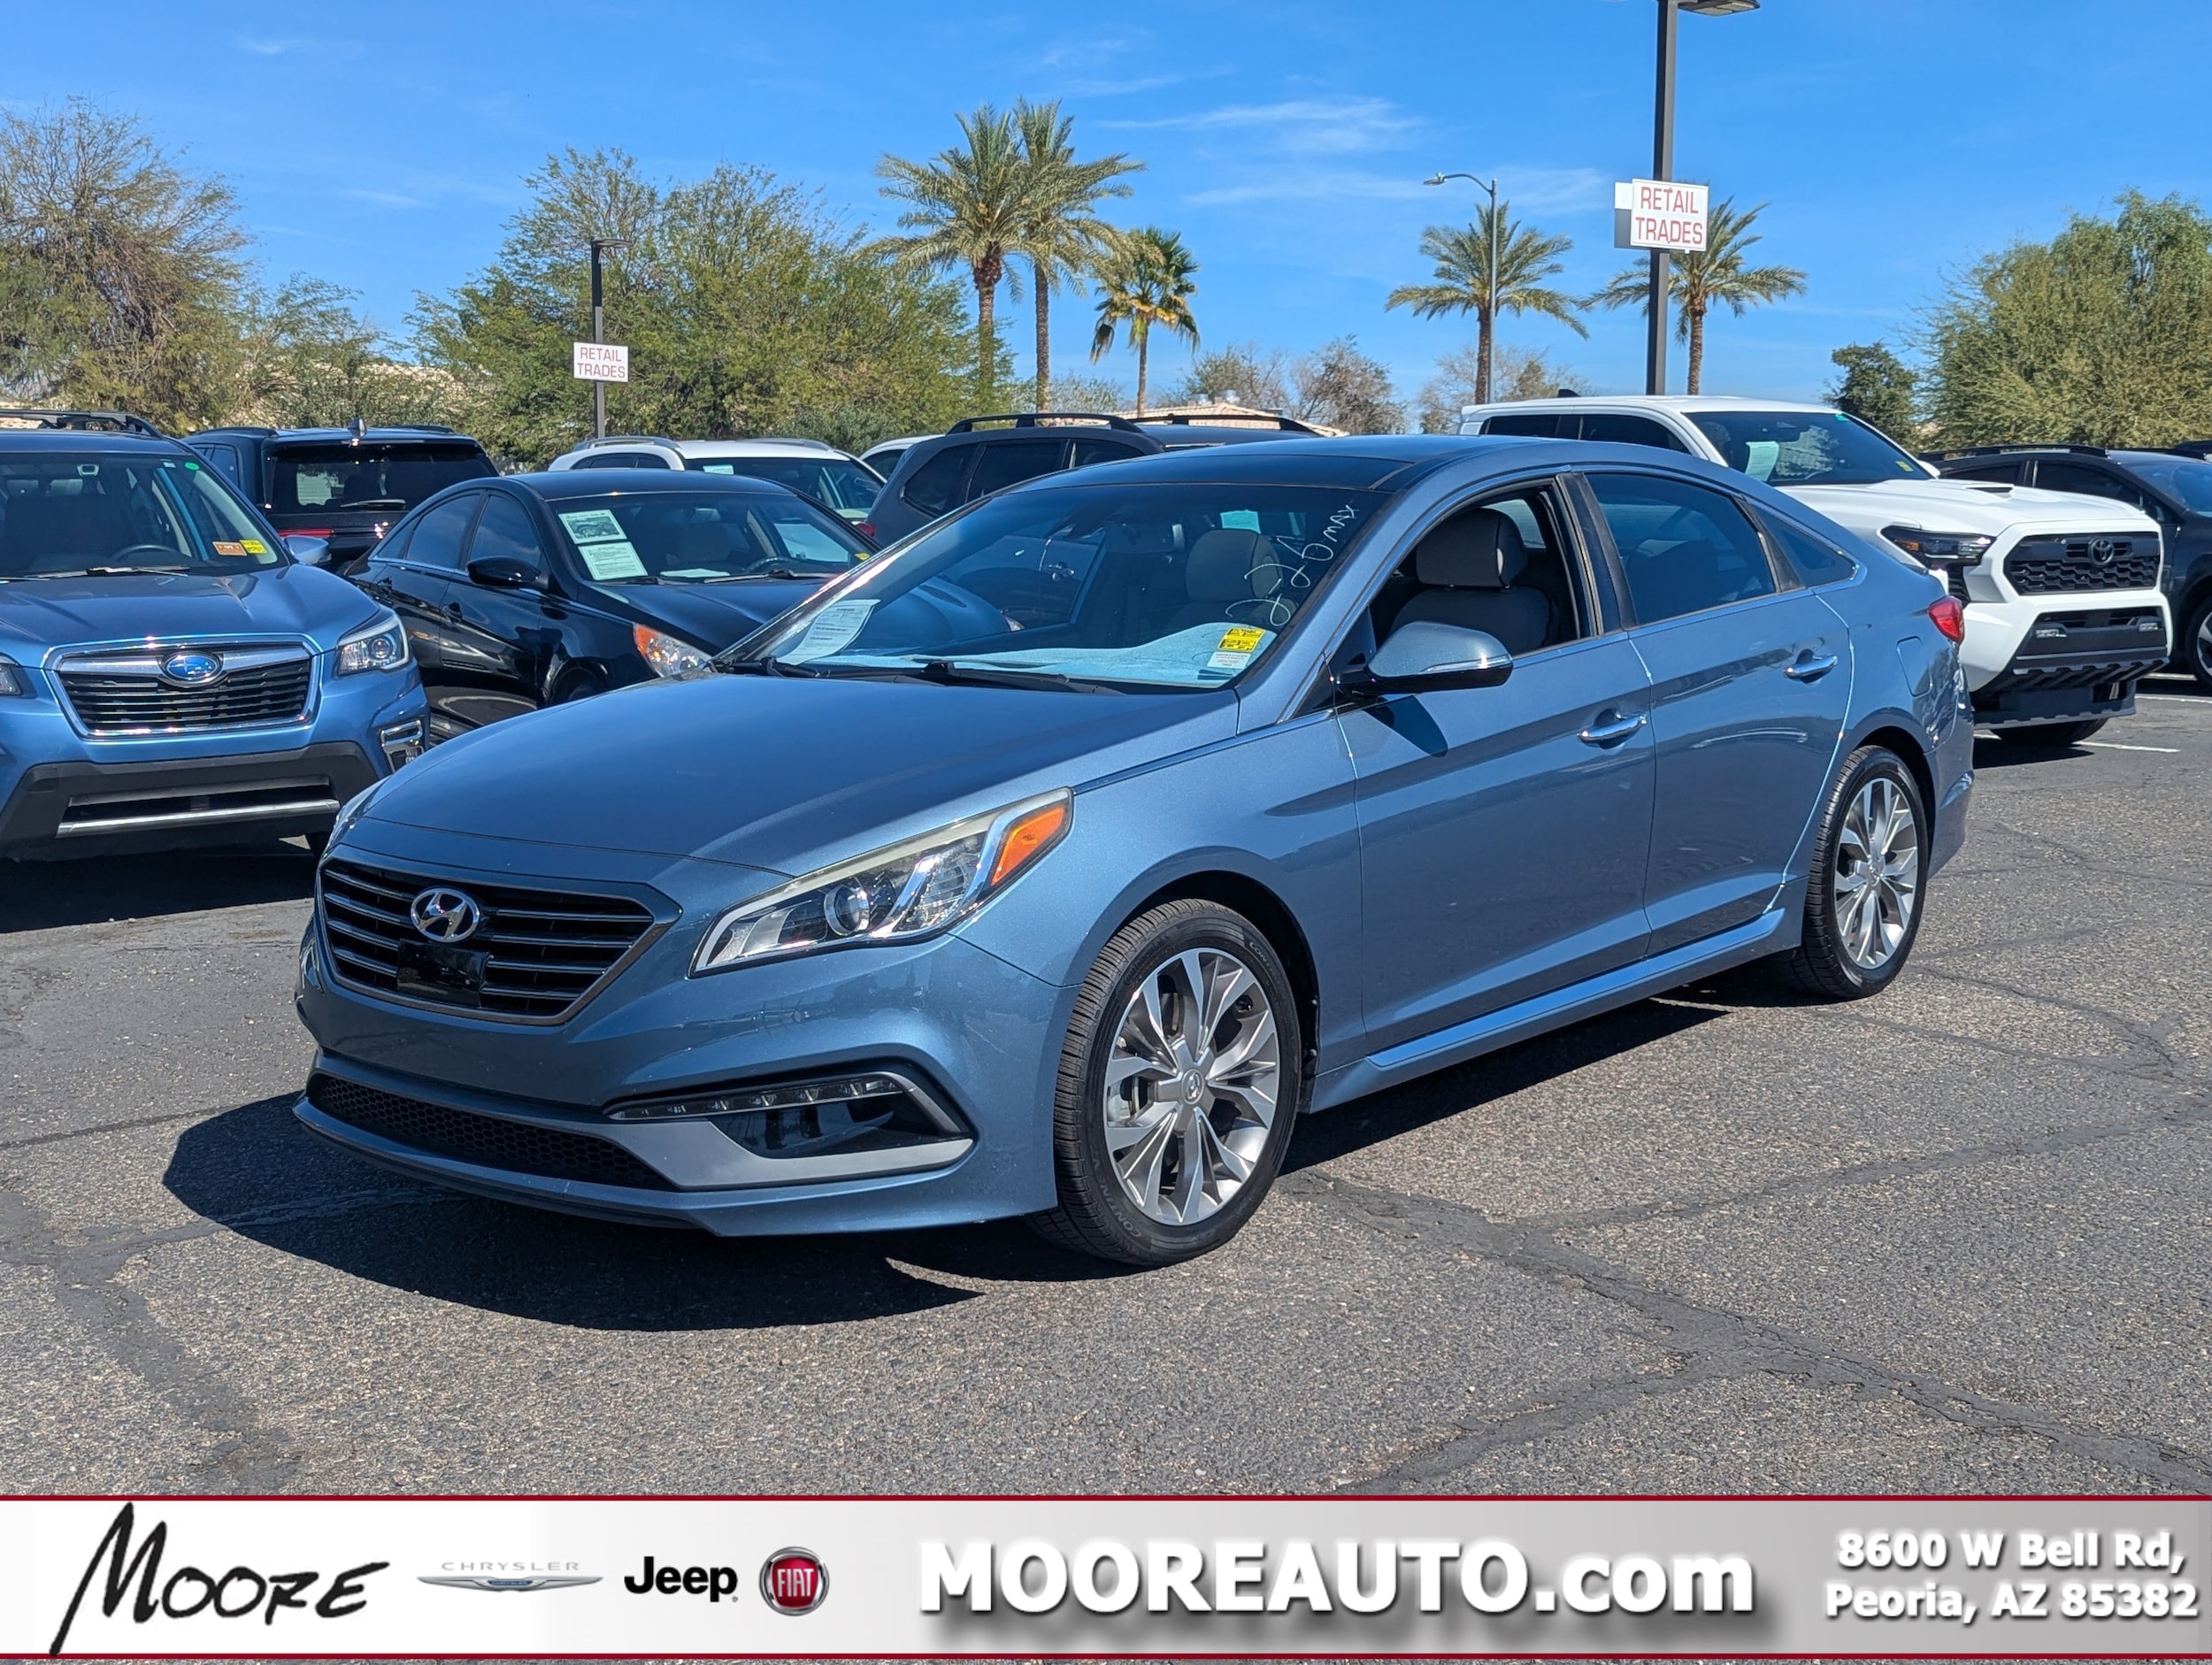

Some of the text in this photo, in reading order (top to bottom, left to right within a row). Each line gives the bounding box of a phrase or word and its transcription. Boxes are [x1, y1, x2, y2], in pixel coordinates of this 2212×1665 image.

[1640, 186, 1699, 214] RETAIL
[1635, 217, 1703, 245] TRADES
[580, 347, 622, 362] RETAIL
[577, 363, 626, 378] TRADES
